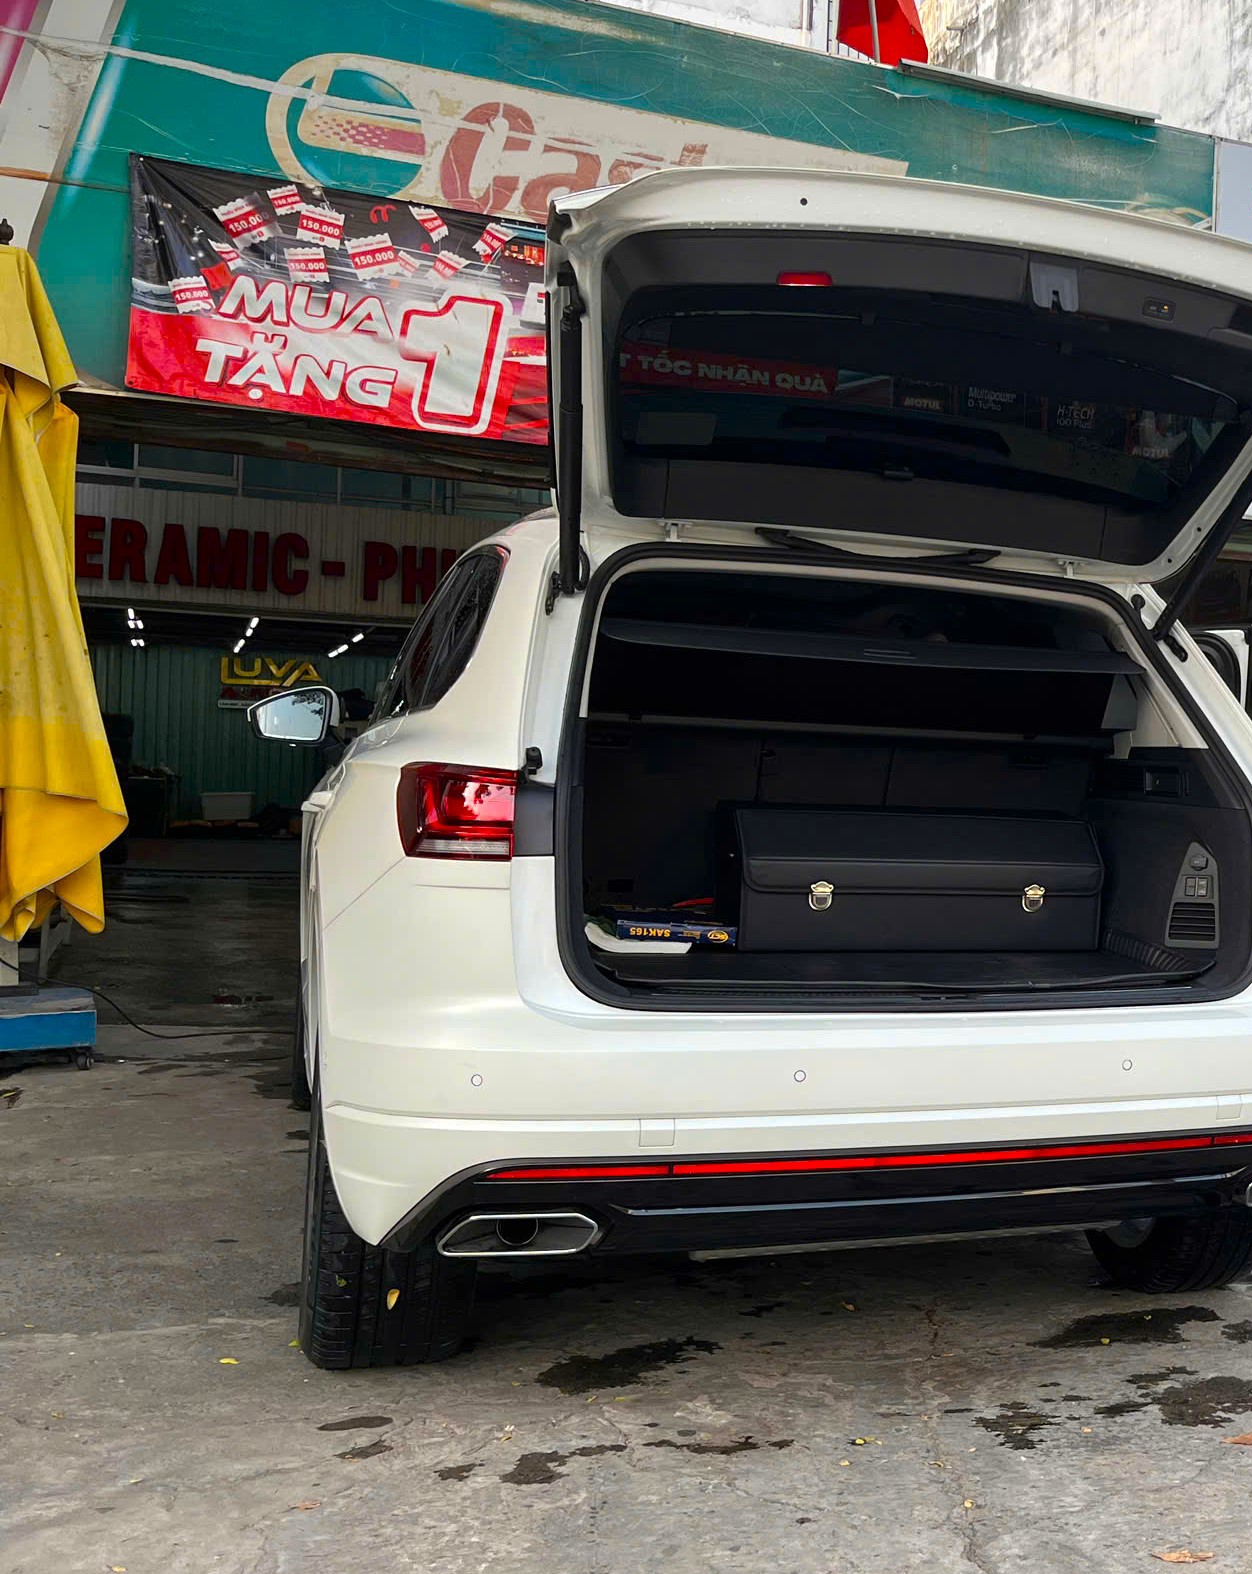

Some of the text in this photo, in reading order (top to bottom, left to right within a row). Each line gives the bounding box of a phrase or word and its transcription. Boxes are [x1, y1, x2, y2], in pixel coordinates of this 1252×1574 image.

[302, 218, 340, 237] 150.000
[290, 262, 325, 271] 150.000
[354, 250, 395, 267] 150.000
[175, 290, 209, 301] 150.000
[218, 275, 394, 341] MUA
[195, 292, 508, 430] TẶNG 1
[637, 350, 692, 376] TỐC
[698, 363, 770, 387] NHẬN
[774, 372, 829, 394] QUÀ
[904, 397, 942, 410] MOTUL
[364, 541, 457, 605] PH
[221, 657, 323, 688] LUVA
[629, 927, 671, 938] SAK165
